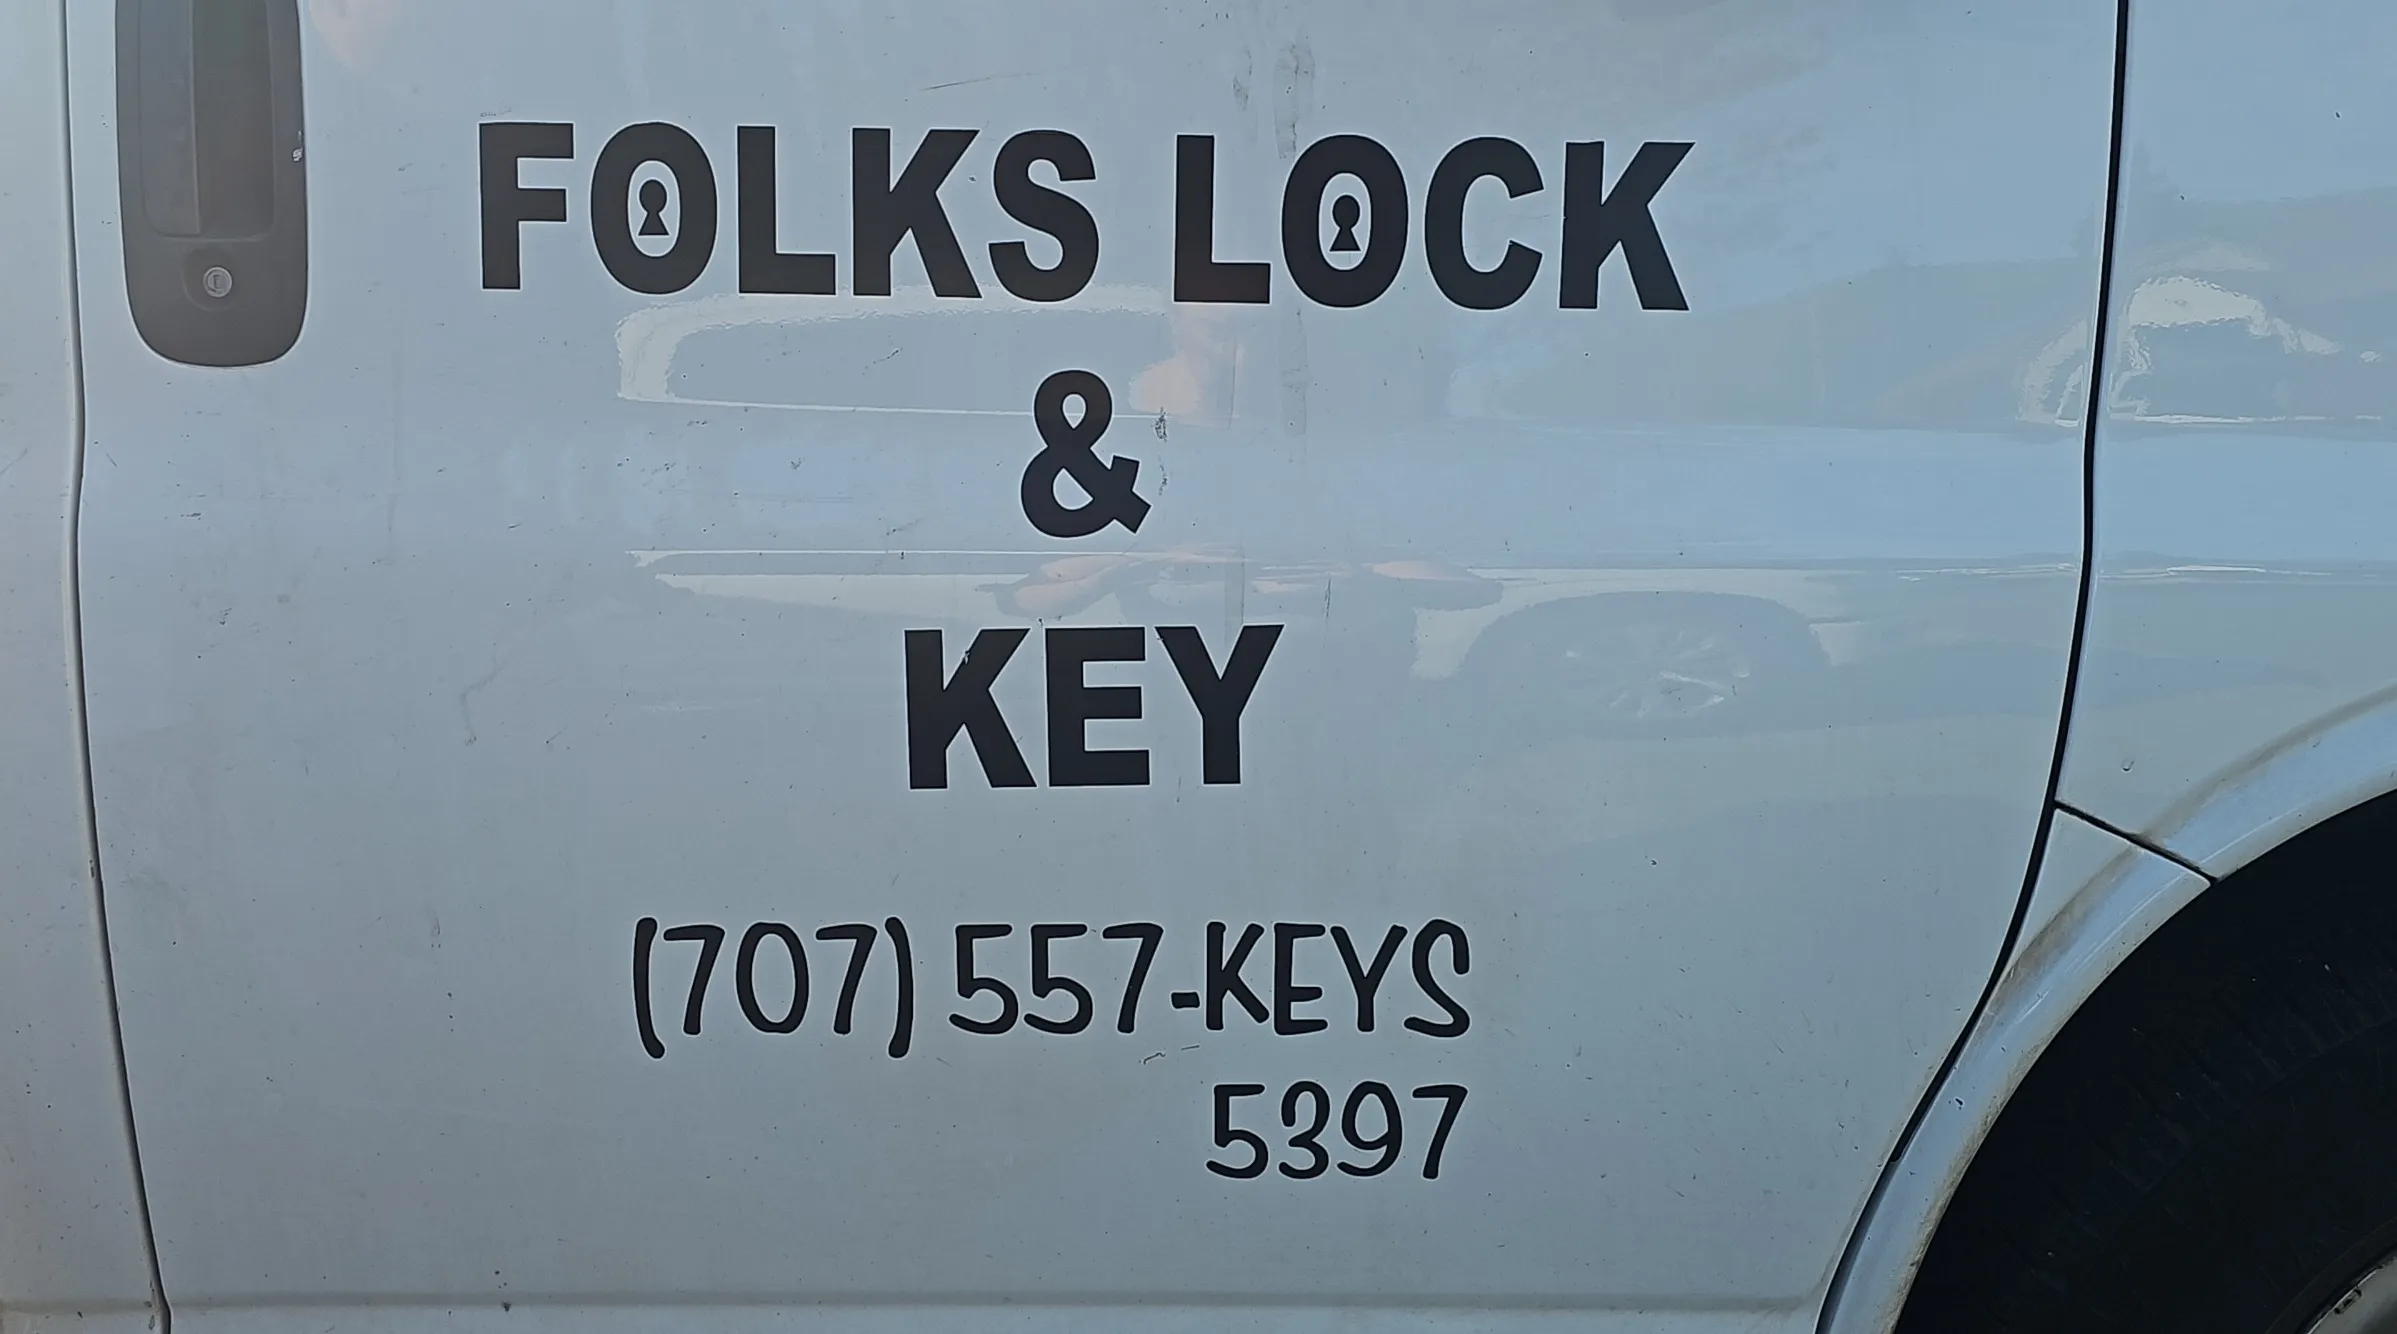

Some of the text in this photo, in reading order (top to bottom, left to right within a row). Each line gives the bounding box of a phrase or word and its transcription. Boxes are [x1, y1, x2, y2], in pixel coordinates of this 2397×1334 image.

[479, 121, 1696, 311] FOLKS LOCK
[1020, 369, 1152, 538] &
[904, 624, 1285, 790] KEY
[632, 916, 1471, 1059] (707) 557-KEYS
[1205, 1080, 1469, 1182] 5397
